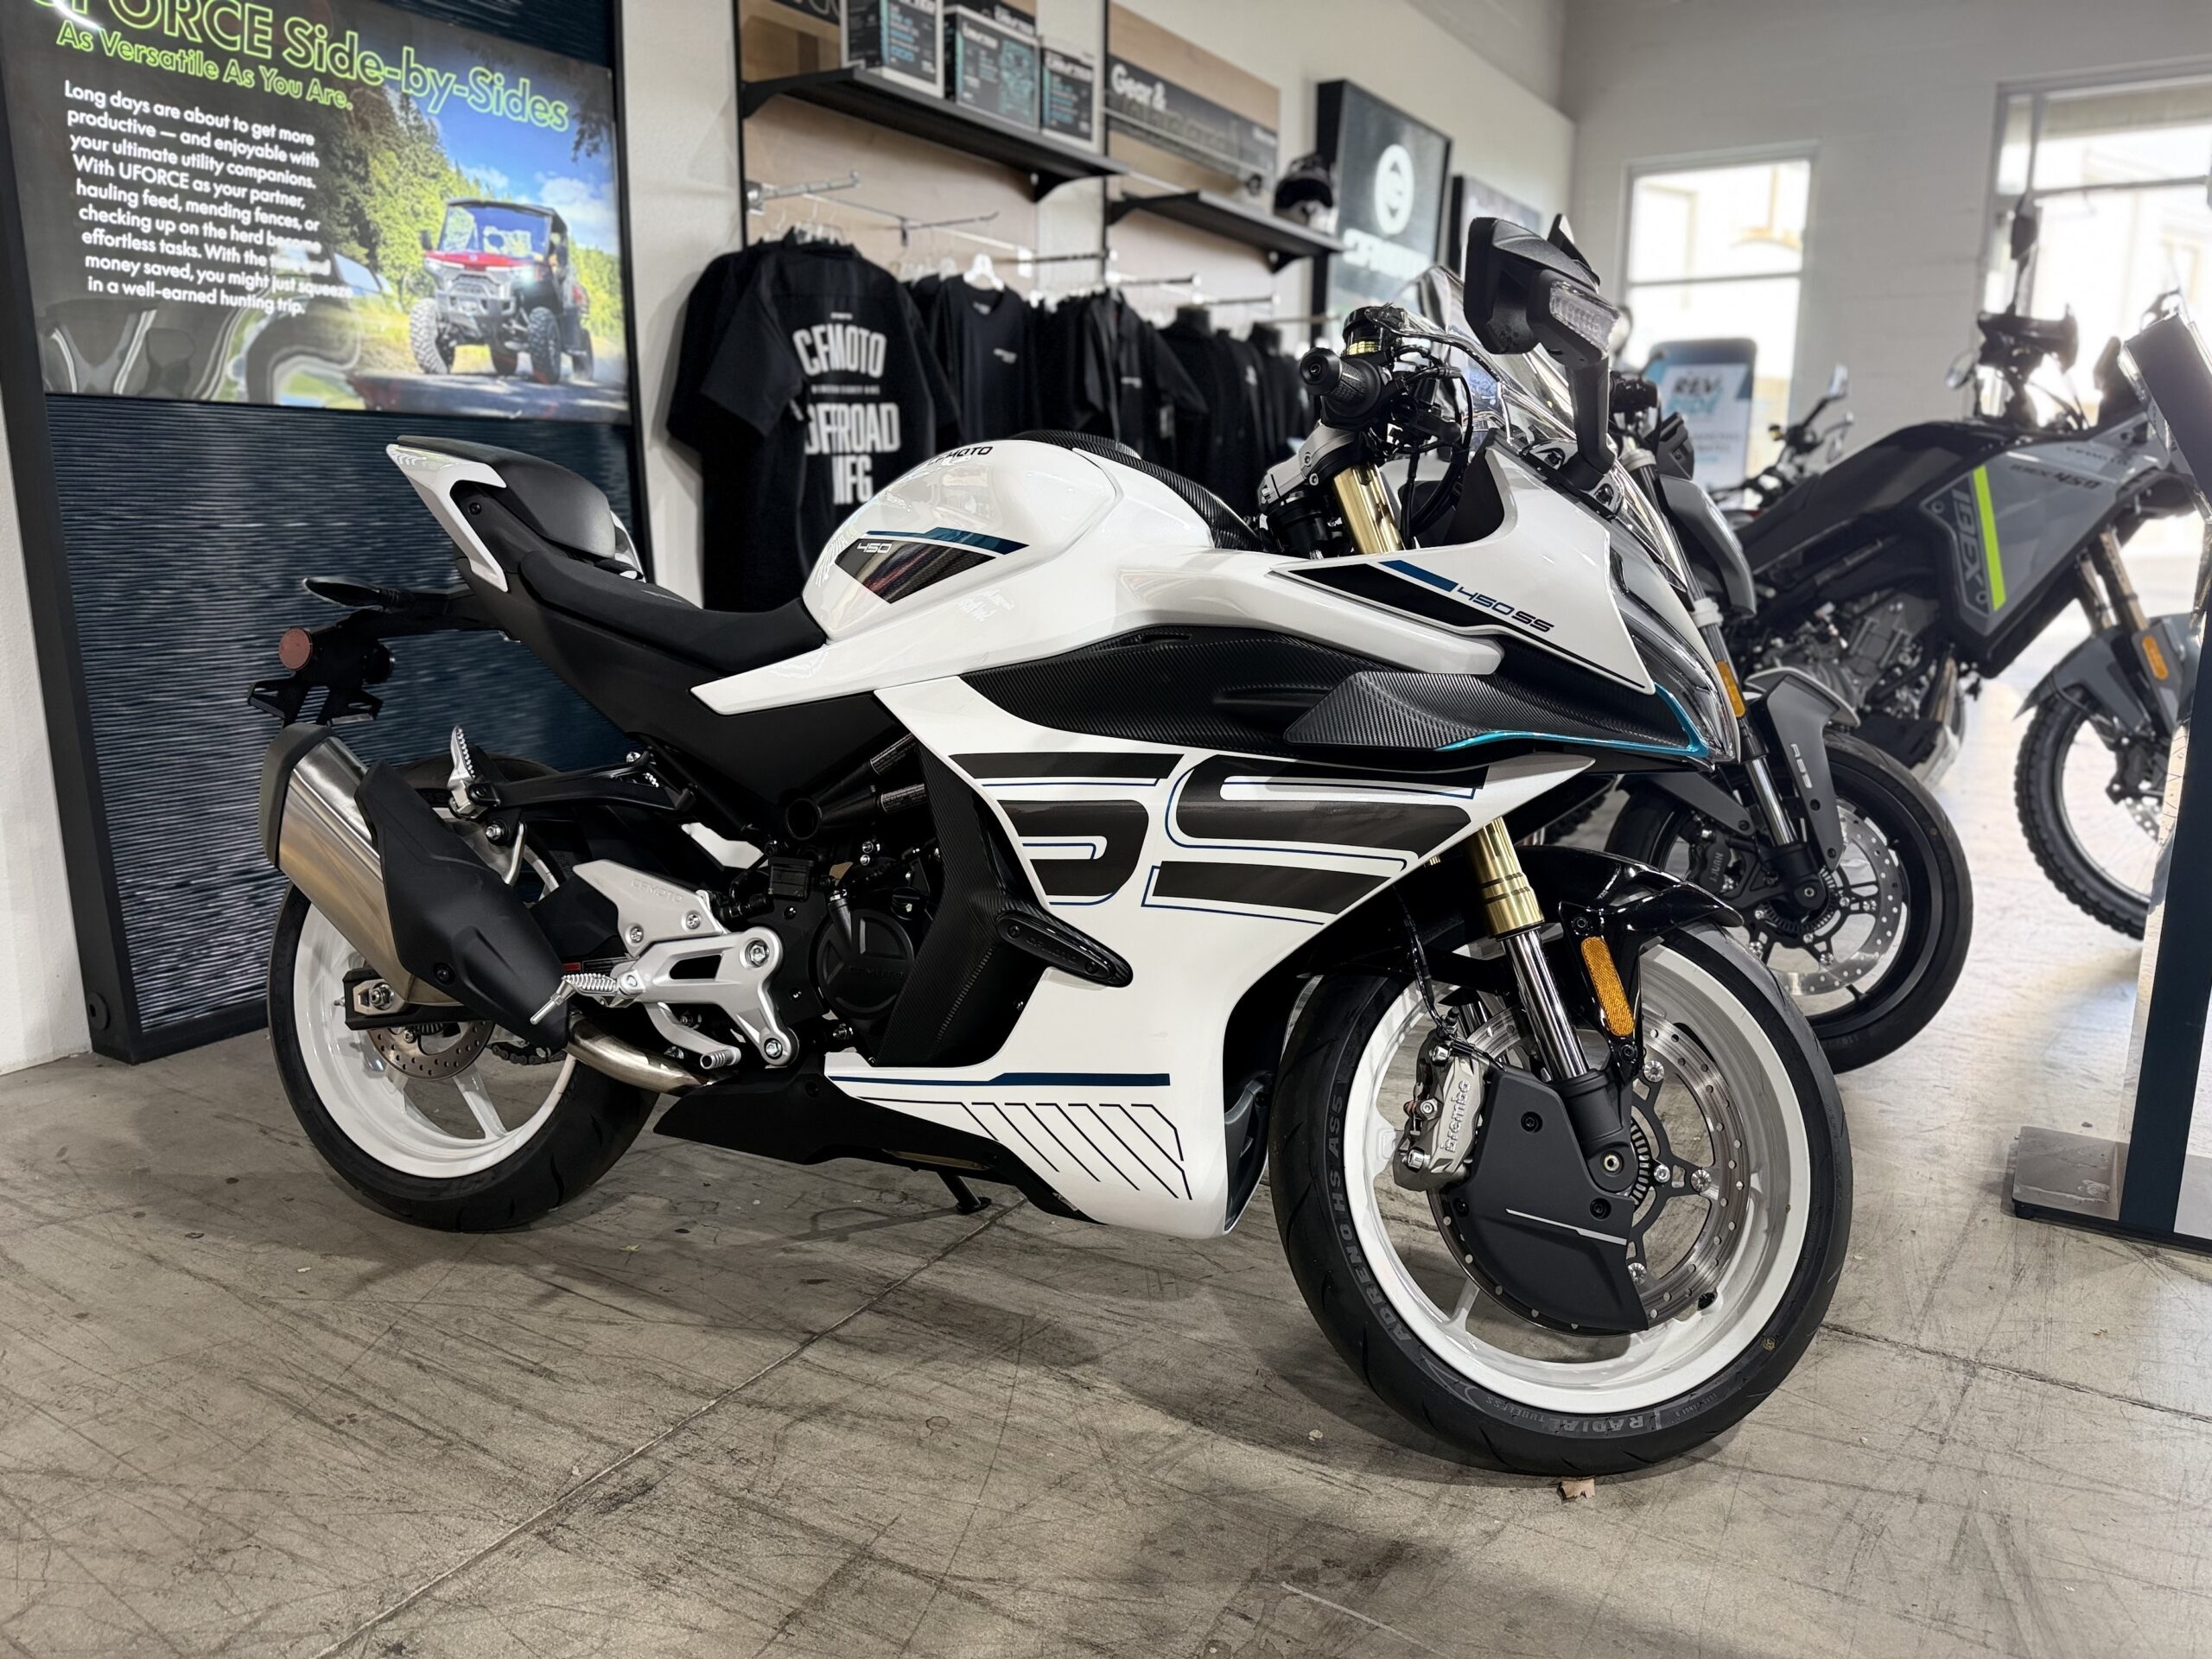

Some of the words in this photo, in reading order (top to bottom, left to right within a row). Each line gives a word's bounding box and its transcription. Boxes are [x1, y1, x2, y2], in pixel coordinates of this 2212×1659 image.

[56, 19, 94, 51] As
[99, 27, 219, 79] Versatile
[223, 59, 256, 88] As
[258, 65, 302, 99] You
[306, 78, 353, 111] Are.
[283, 16, 569, 132] Side-by-Sides
[1111, 64, 1153, 105] Gear
[65, 79, 105, 109] Long
[110, 90, 151, 115] days
[153, 103, 181, 119] are
[183, 106, 231, 130] about
[232, 117, 249, 133] to
[251, 124, 276, 140] get
[279, 129, 315, 146] more
[67, 110, 156, 137] productive
[180, 131, 211, 148] and
[214, 138, 288, 162] enjoyable
[289, 151, 320, 168] with
[70, 134, 109, 151] your
[112, 138, 178, 164] ultimate
[181, 153, 224, 176] utility
[226, 163, 316, 189] companions.
[73, 154, 115, 177] With
[119, 162, 189, 190] UFORCE
[193, 180, 211, 193] as
[213, 182, 248, 199] your
[250, 188, 306, 211] partner,
[76, 177, 139, 208] hauling
[142, 188, 182, 213] feed,
[186, 200, 251, 226] mending
[254, 207, 302, 231] fences,
[304, 219, 321, 232] or
[79, 203, 152, 233] checking
[156, 218, 176, 236] up
[179, 222, 200, 235] on
[202, 221, 227, 239] the
[230, 225, 264, 245] herd
[81, 227, 156, 252] effortless
[159, 238, 202, 258] tasks.
[204, 243, 241, 264] With
[245, 249, 268, 267] the
[85, 255, 141, 277] money
[143, 263, 194, 282] saved,
[196, 269, 225, 284] you
[228, 270, 270, 291] might
[271, 275, 296, 293] just
[298, 281, 354, 299] squeeze
[88, 276, 104, 293] in
[106, 281, 119, 295] a
[122, 280, 217, 305] well-earned
[220, 289, 275, 315] hunting
[276, 298, 306, 316] trip.
[793, 323, 887, 378] CFMOTO
[856, 543, 893, 554] 450
[1951, 488, 1985, 587] IBEX
[1790, 743, 1814, 789] ABS
[631, 878, 684, 903] CFMOTO
[1327, 1094, 1344, 1160] AS5
[1440, 1078, 1471, 1154] brembo
[1329, 1170, 1347, 1212] HS
[1340, 1224, 1413, 1343] ADRENO
[1484, 1395, 1545, 1424] TUBELESS
[1554, 1410, 1645, 1433] RADIAL
